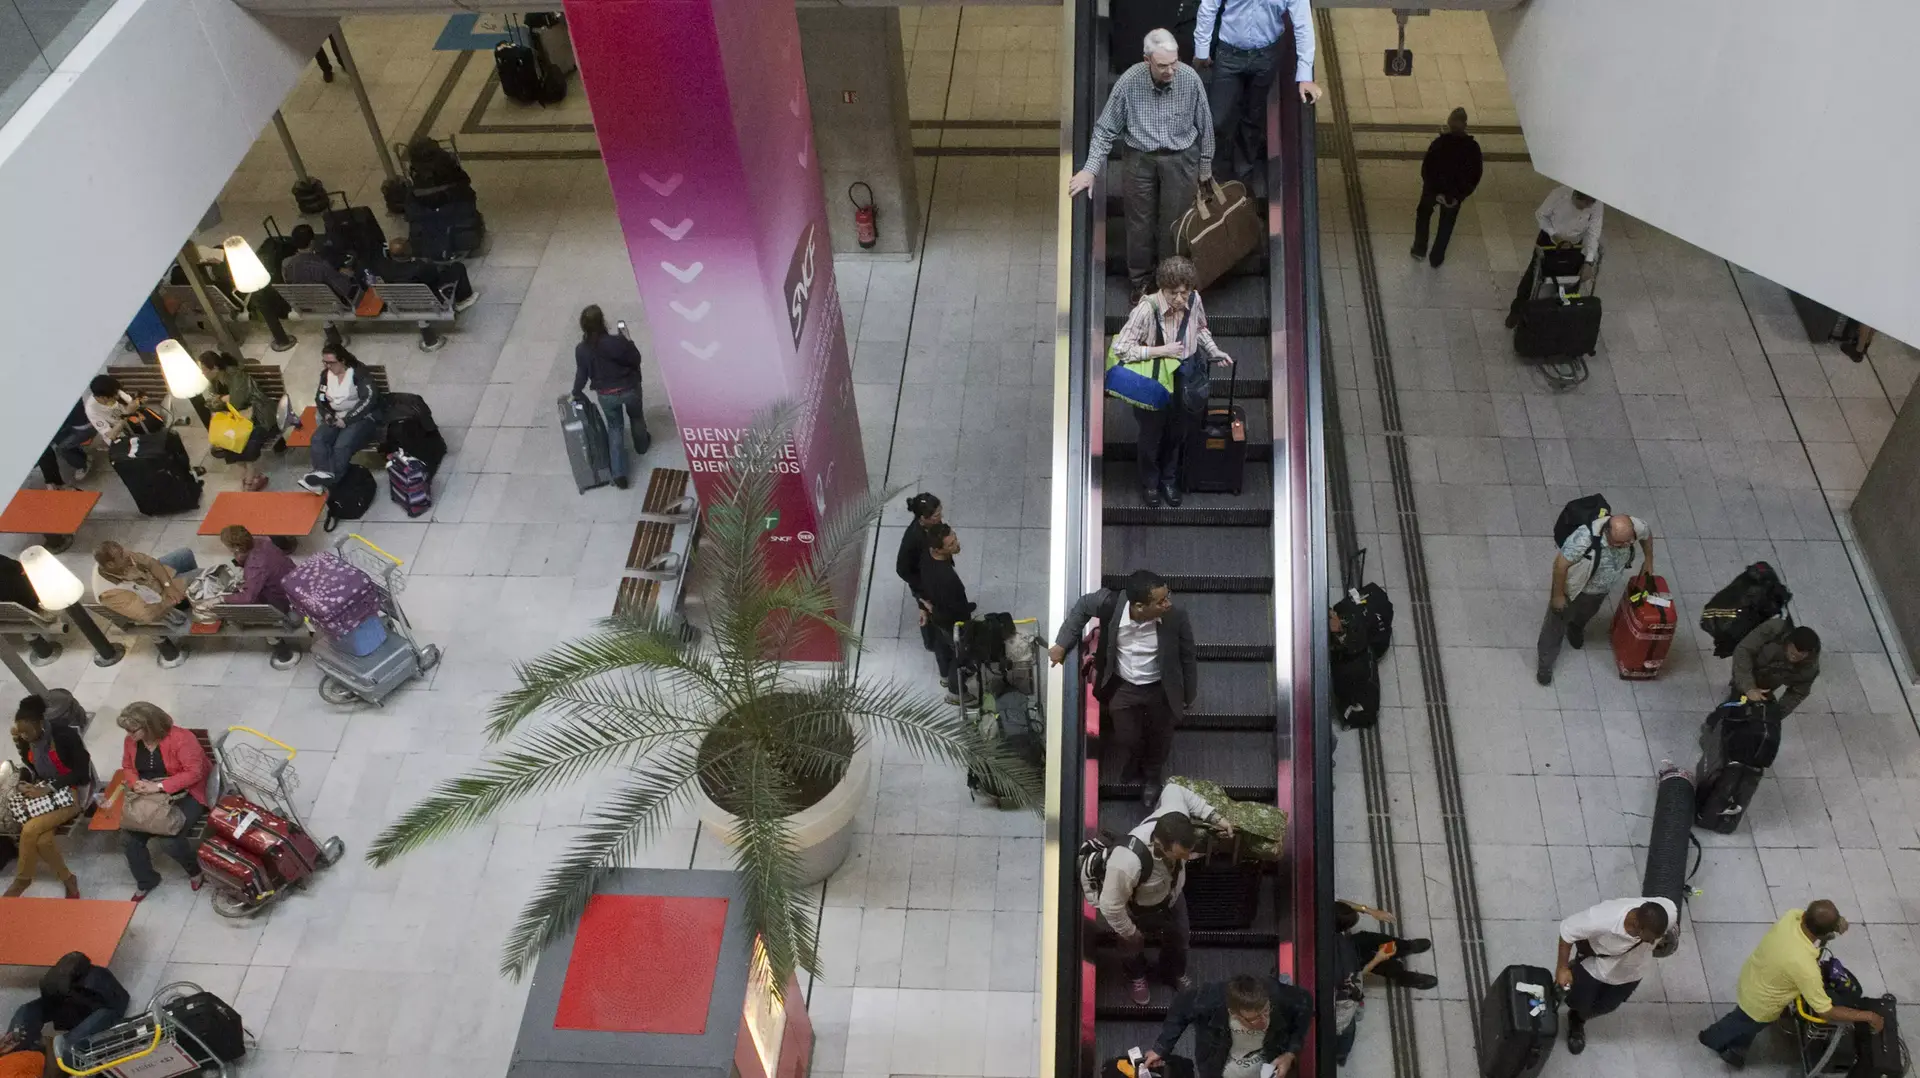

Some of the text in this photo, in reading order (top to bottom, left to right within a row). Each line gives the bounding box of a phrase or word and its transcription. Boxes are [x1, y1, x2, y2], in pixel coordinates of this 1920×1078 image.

[792, 223, 816, 339] SNCF
[683, 427, 795, 442] BIENVE
[692, 460, 800, 474] BIENOS
[770, 535, 792, 543] SNCF
